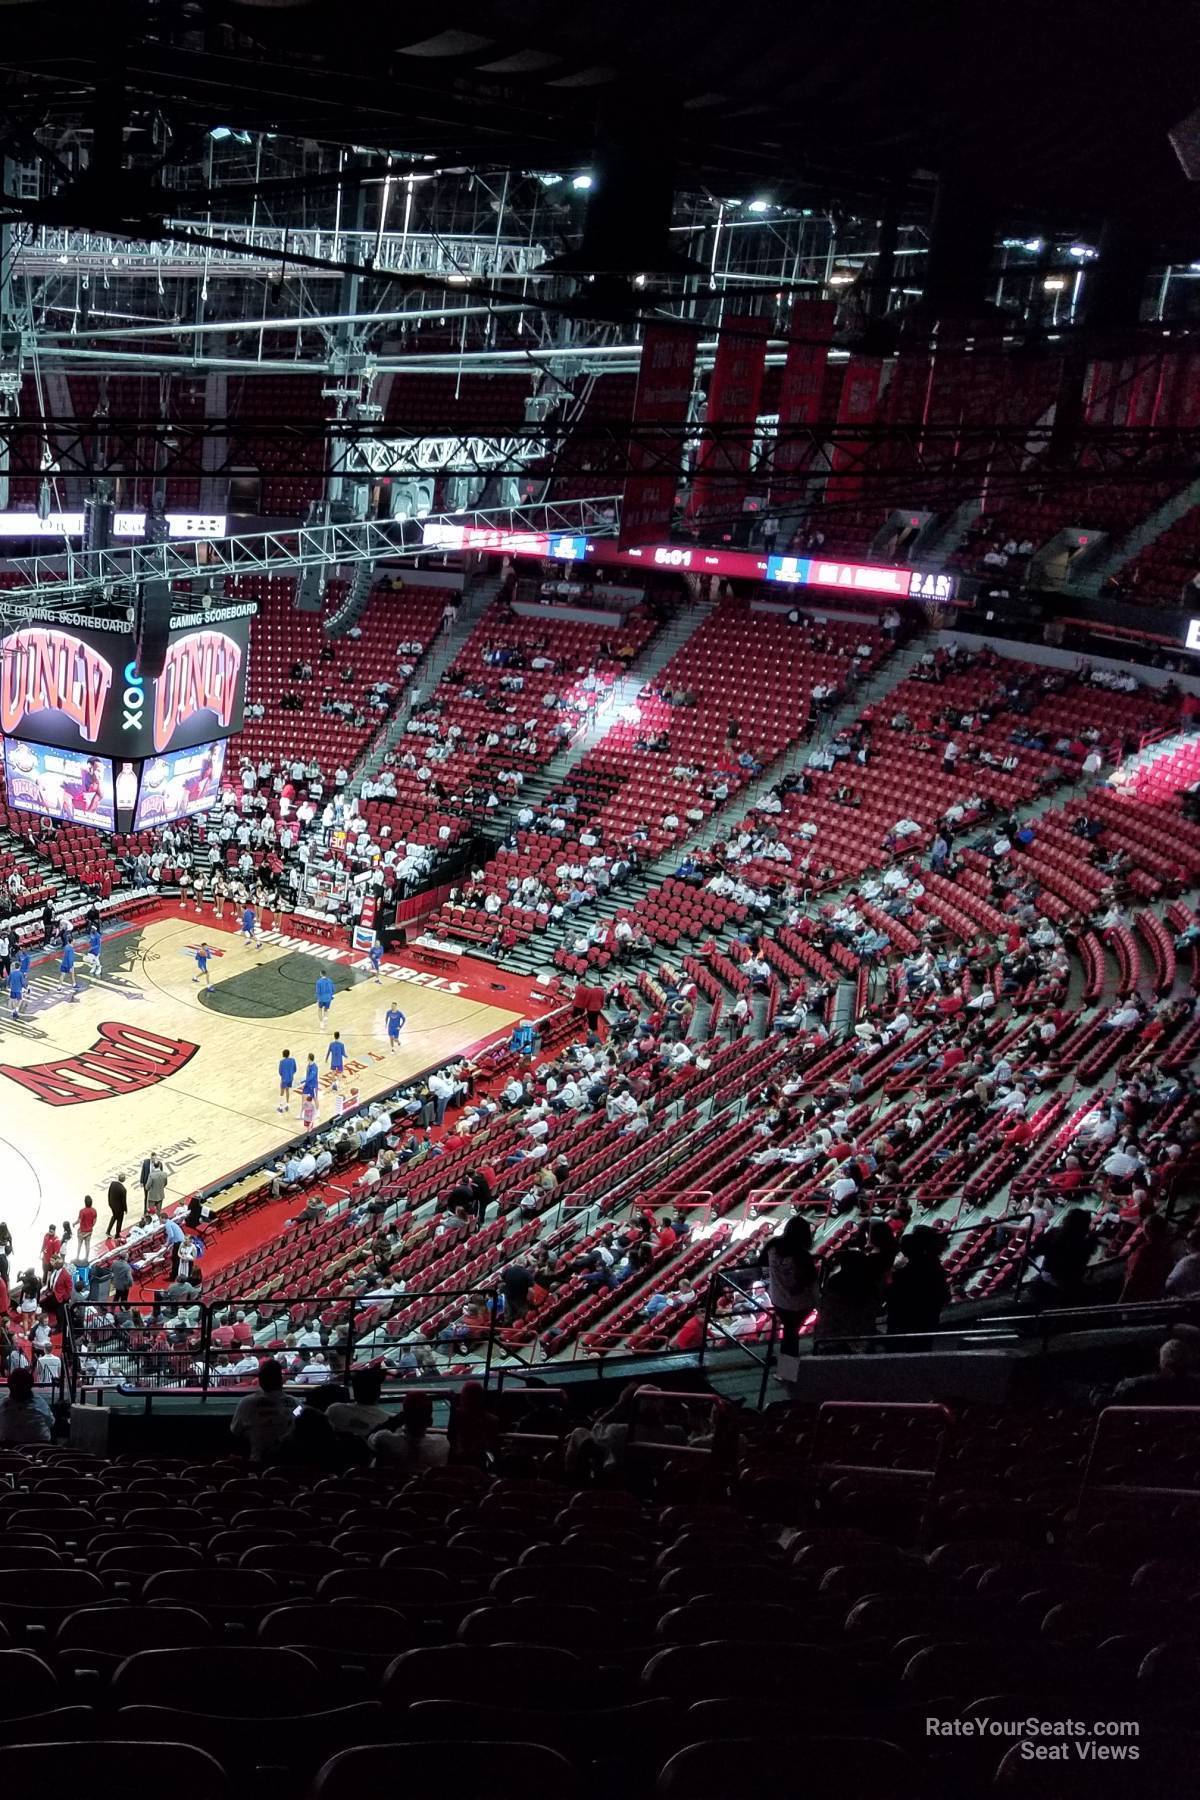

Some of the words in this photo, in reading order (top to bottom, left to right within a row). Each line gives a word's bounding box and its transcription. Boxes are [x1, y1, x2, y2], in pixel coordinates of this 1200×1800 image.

[15, 605, 55, 622] GAMING
[59, 612, 132, 634] SCOREBOARD
[169, 612, 203, 629] GAMING
[204, 602, 258, 624] SCOREBOARD
[0, 628, 113, 744] UNLV
[122, 661, 145, 730] COX
[153, 630, 242, 753] UNLV
